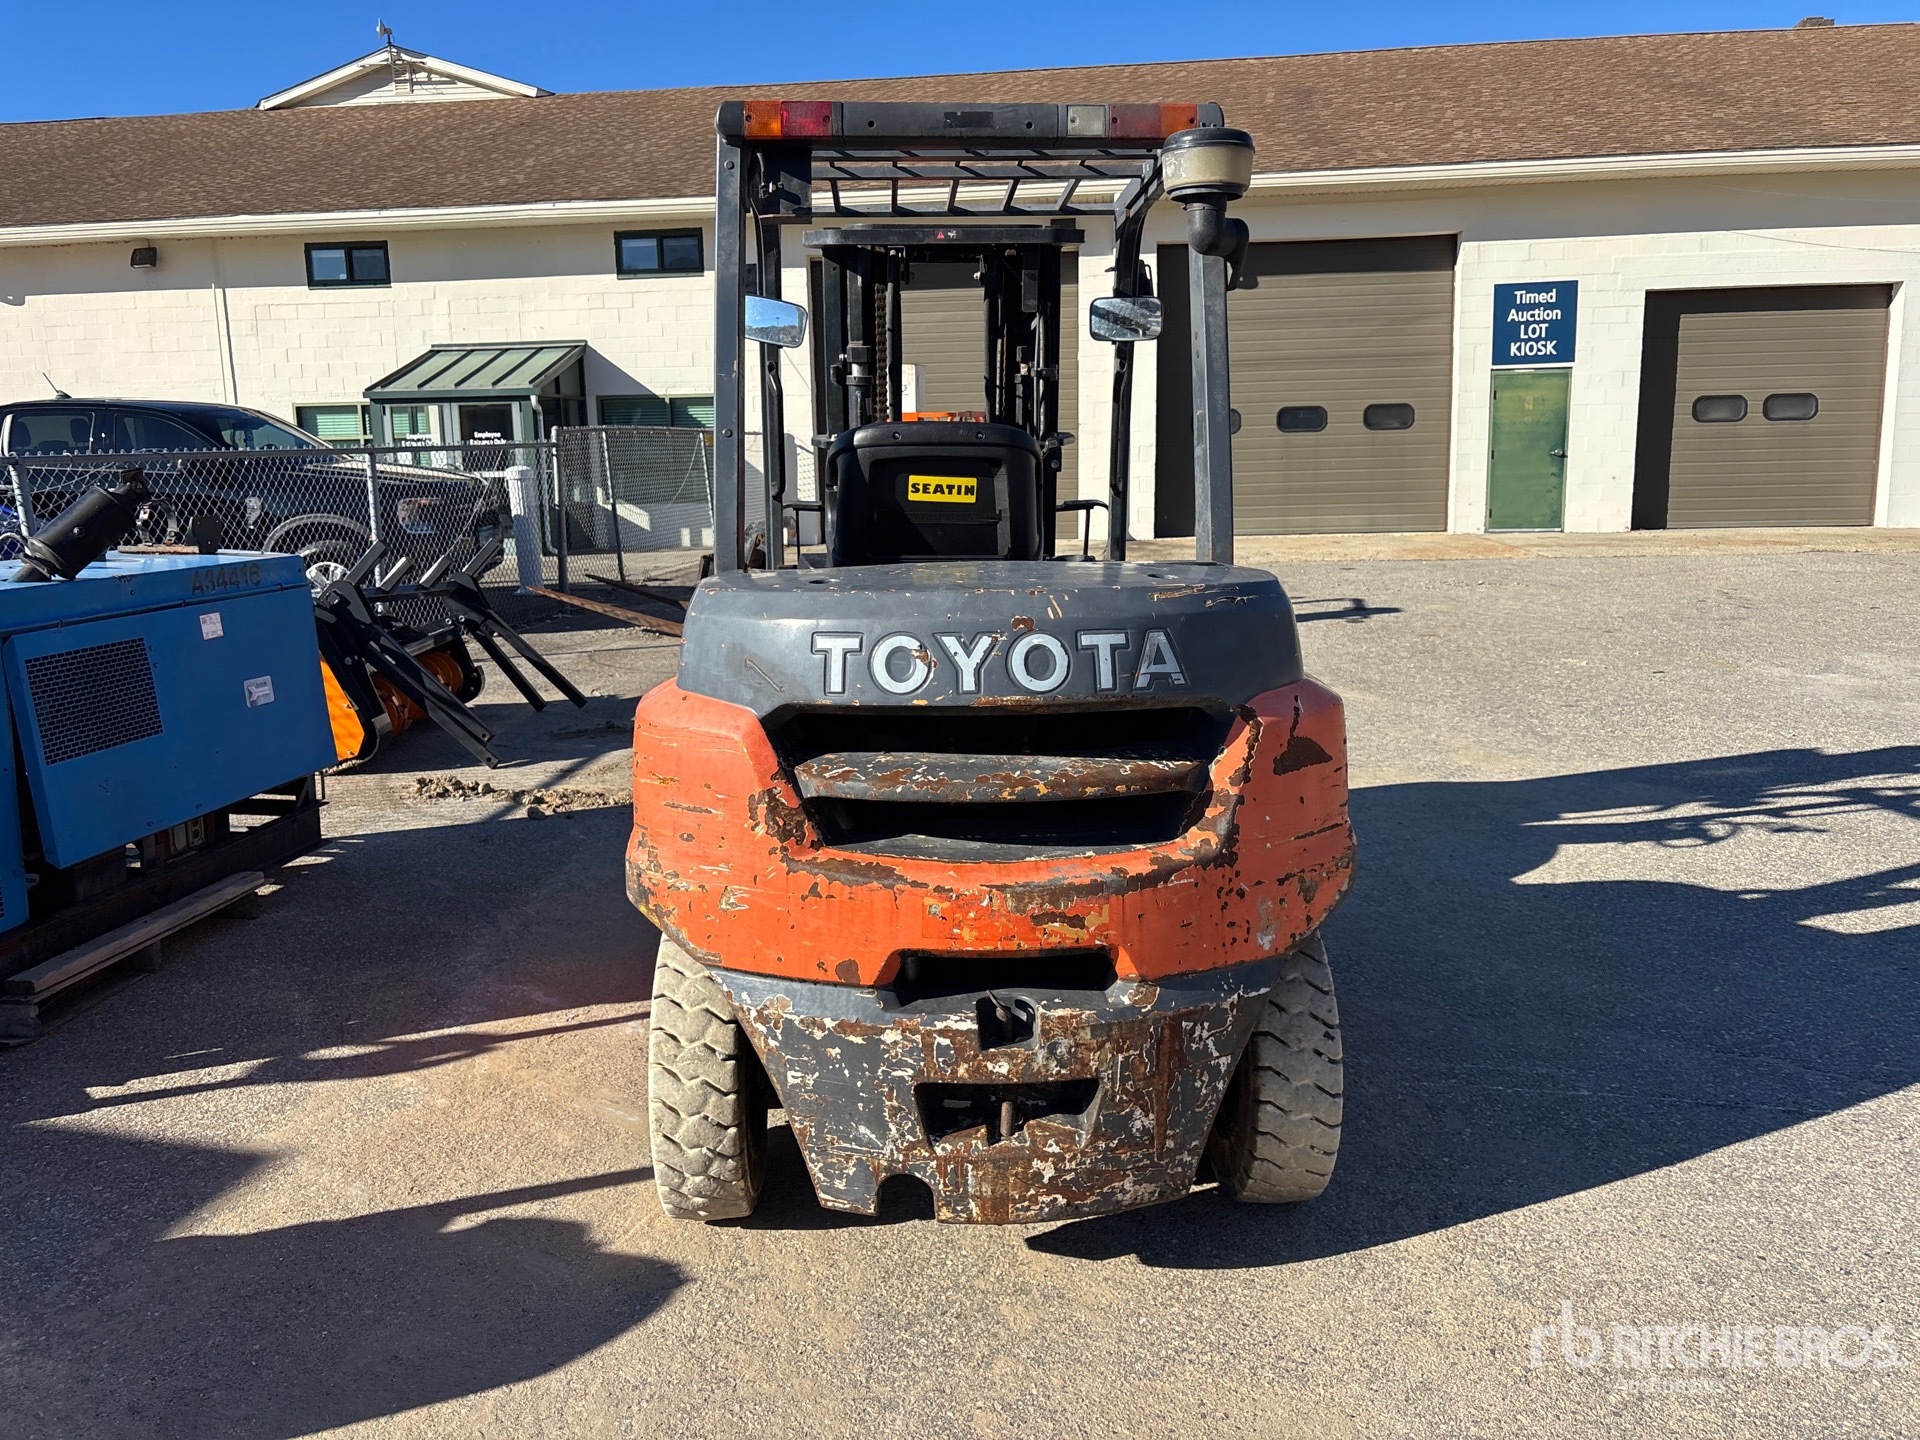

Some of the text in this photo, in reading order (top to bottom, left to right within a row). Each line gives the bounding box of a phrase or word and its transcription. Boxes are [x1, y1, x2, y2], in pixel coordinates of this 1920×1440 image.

[1514, 288, 1557, 305] Timed
[1507, 306, 1562, 322] Auction
[1520, 323, 1549, 339] LOT
[1510, 340, 1557, 357] KIOSK
[473, 431, 501, 439] Employee
[910, 482, 975, 496] SEATIN
[813, 631, 1188, 694] TOYOTA
